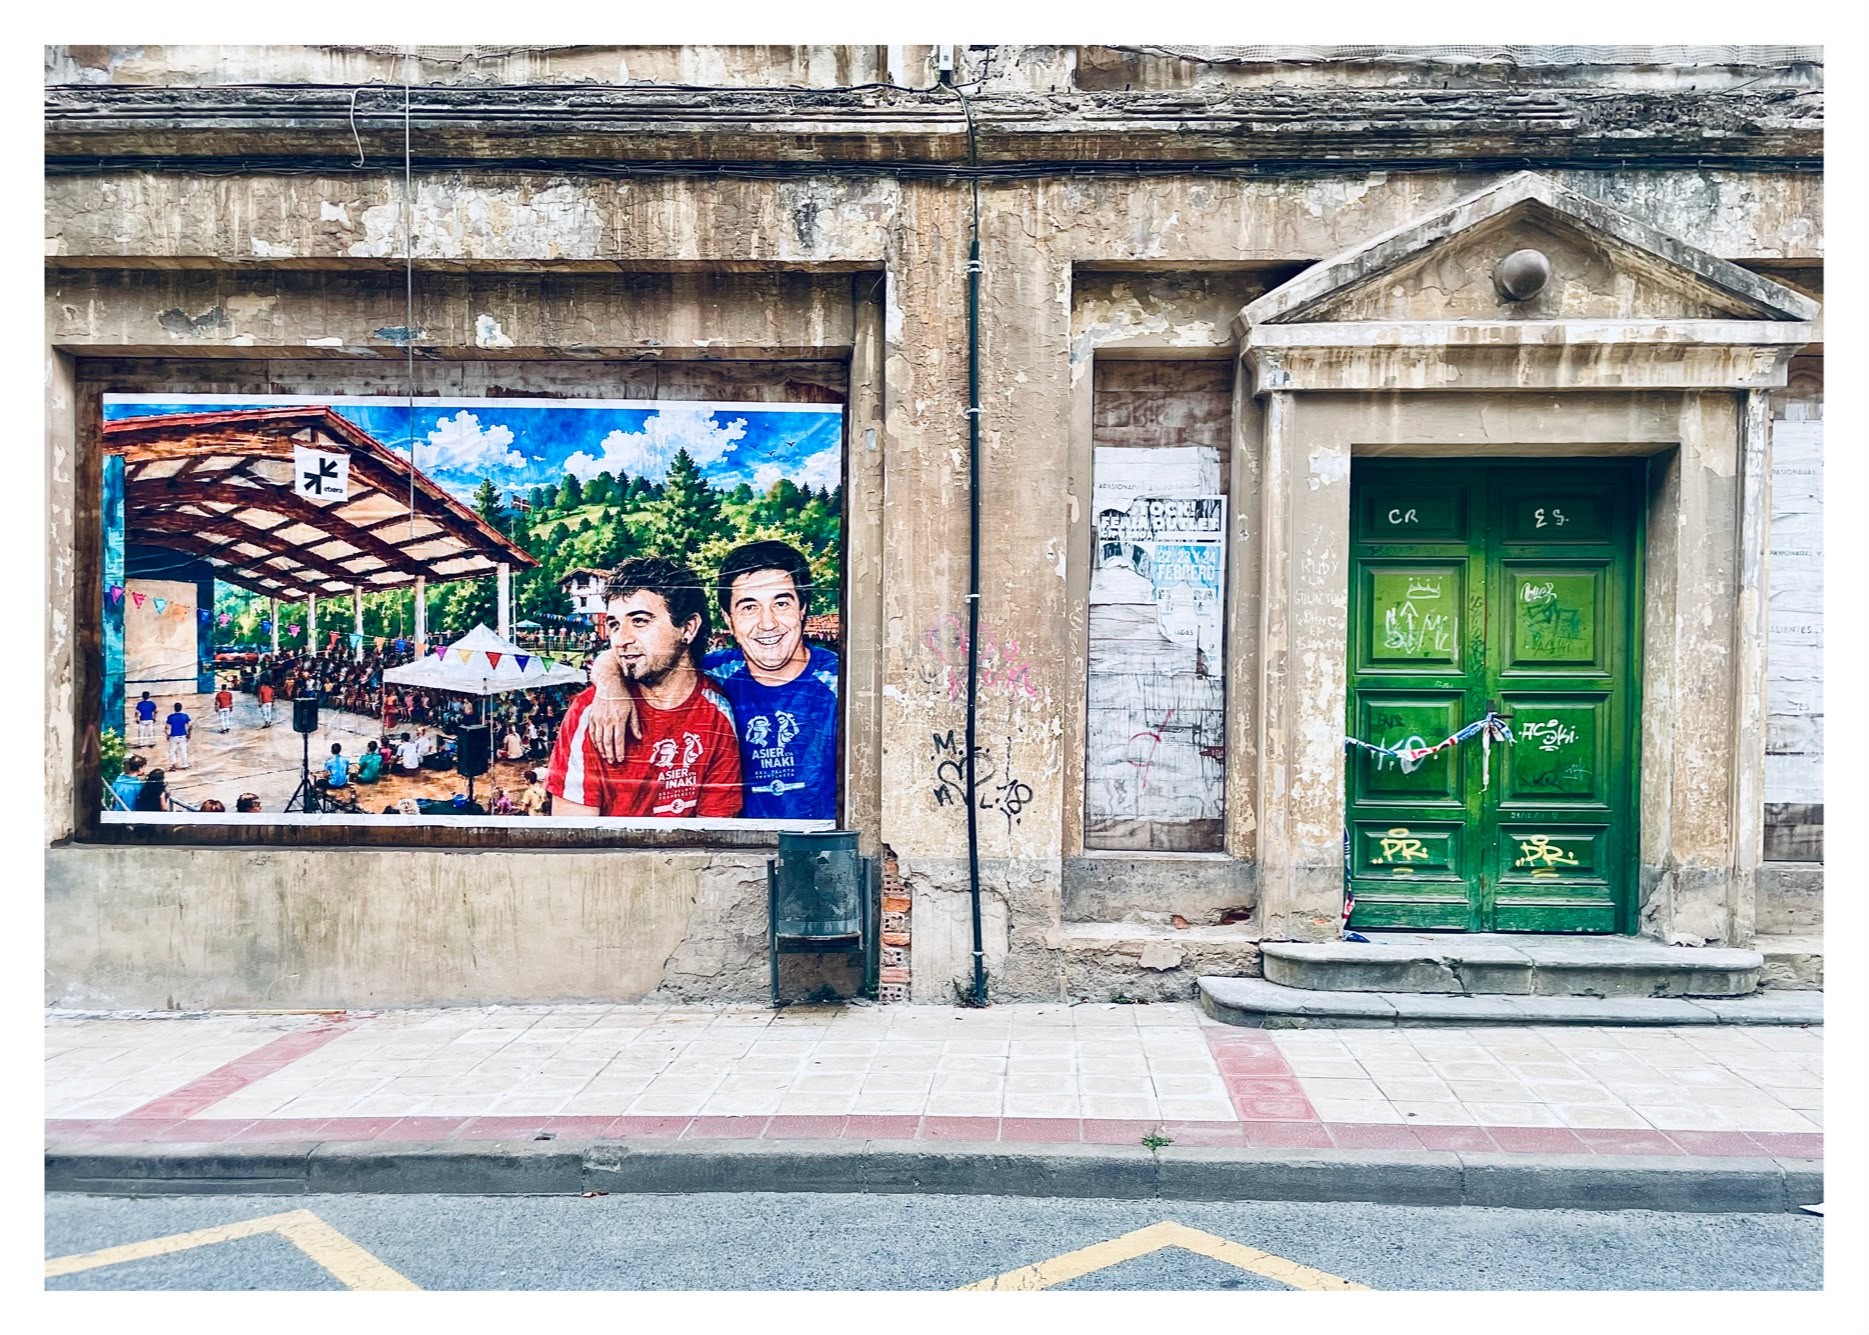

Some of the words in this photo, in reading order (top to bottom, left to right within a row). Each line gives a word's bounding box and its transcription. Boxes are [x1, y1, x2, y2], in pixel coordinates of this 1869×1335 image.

[1158, 564, 1216, 580] FEBRERO
[751, 747, 784, 760] ASIER
[657, 768, 690, 782] ASIER
